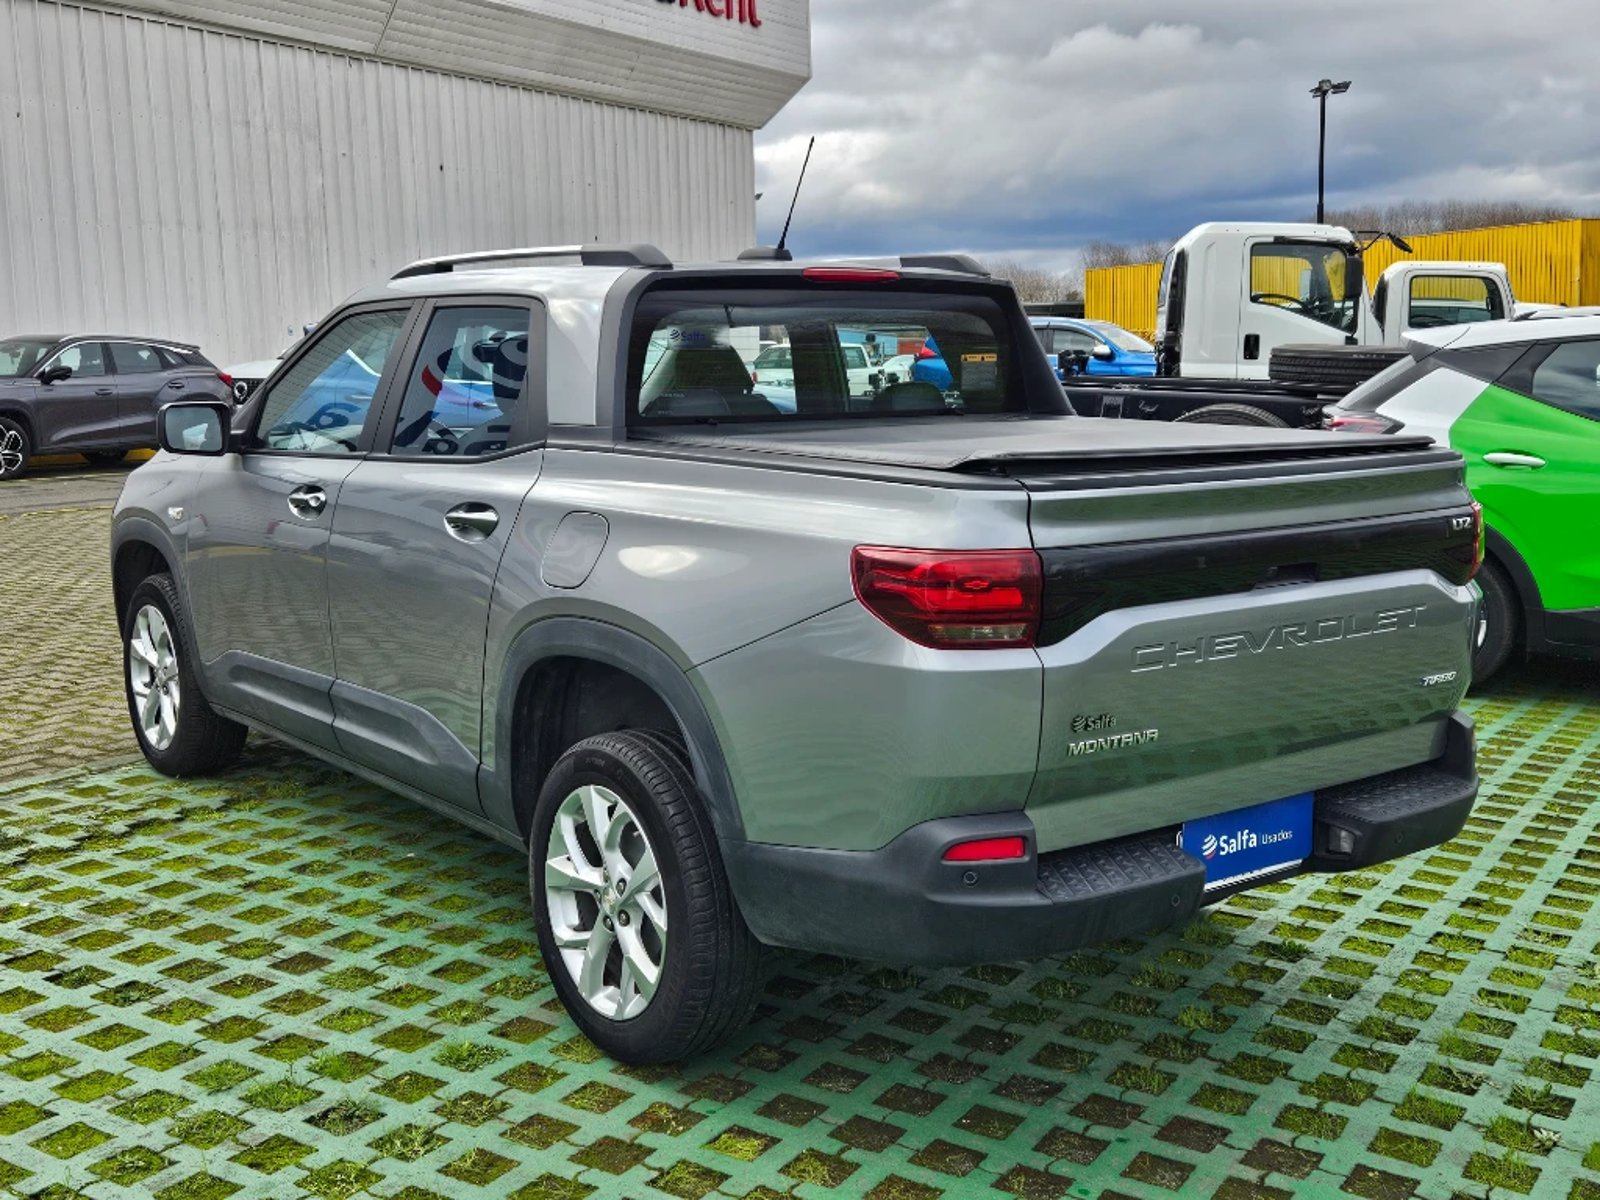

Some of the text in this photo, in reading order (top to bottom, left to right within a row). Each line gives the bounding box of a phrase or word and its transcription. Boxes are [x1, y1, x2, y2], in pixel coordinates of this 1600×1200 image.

[1131, 602, 1427, 673] CHEVROLET
[1422, 671, 1457, 687] TURBO
[1086, 713, 1117, 731] Salfa
[1067, 728, 1159, 757] MONTANA
[1219, 829, 1293, 856] Salfa Usados
